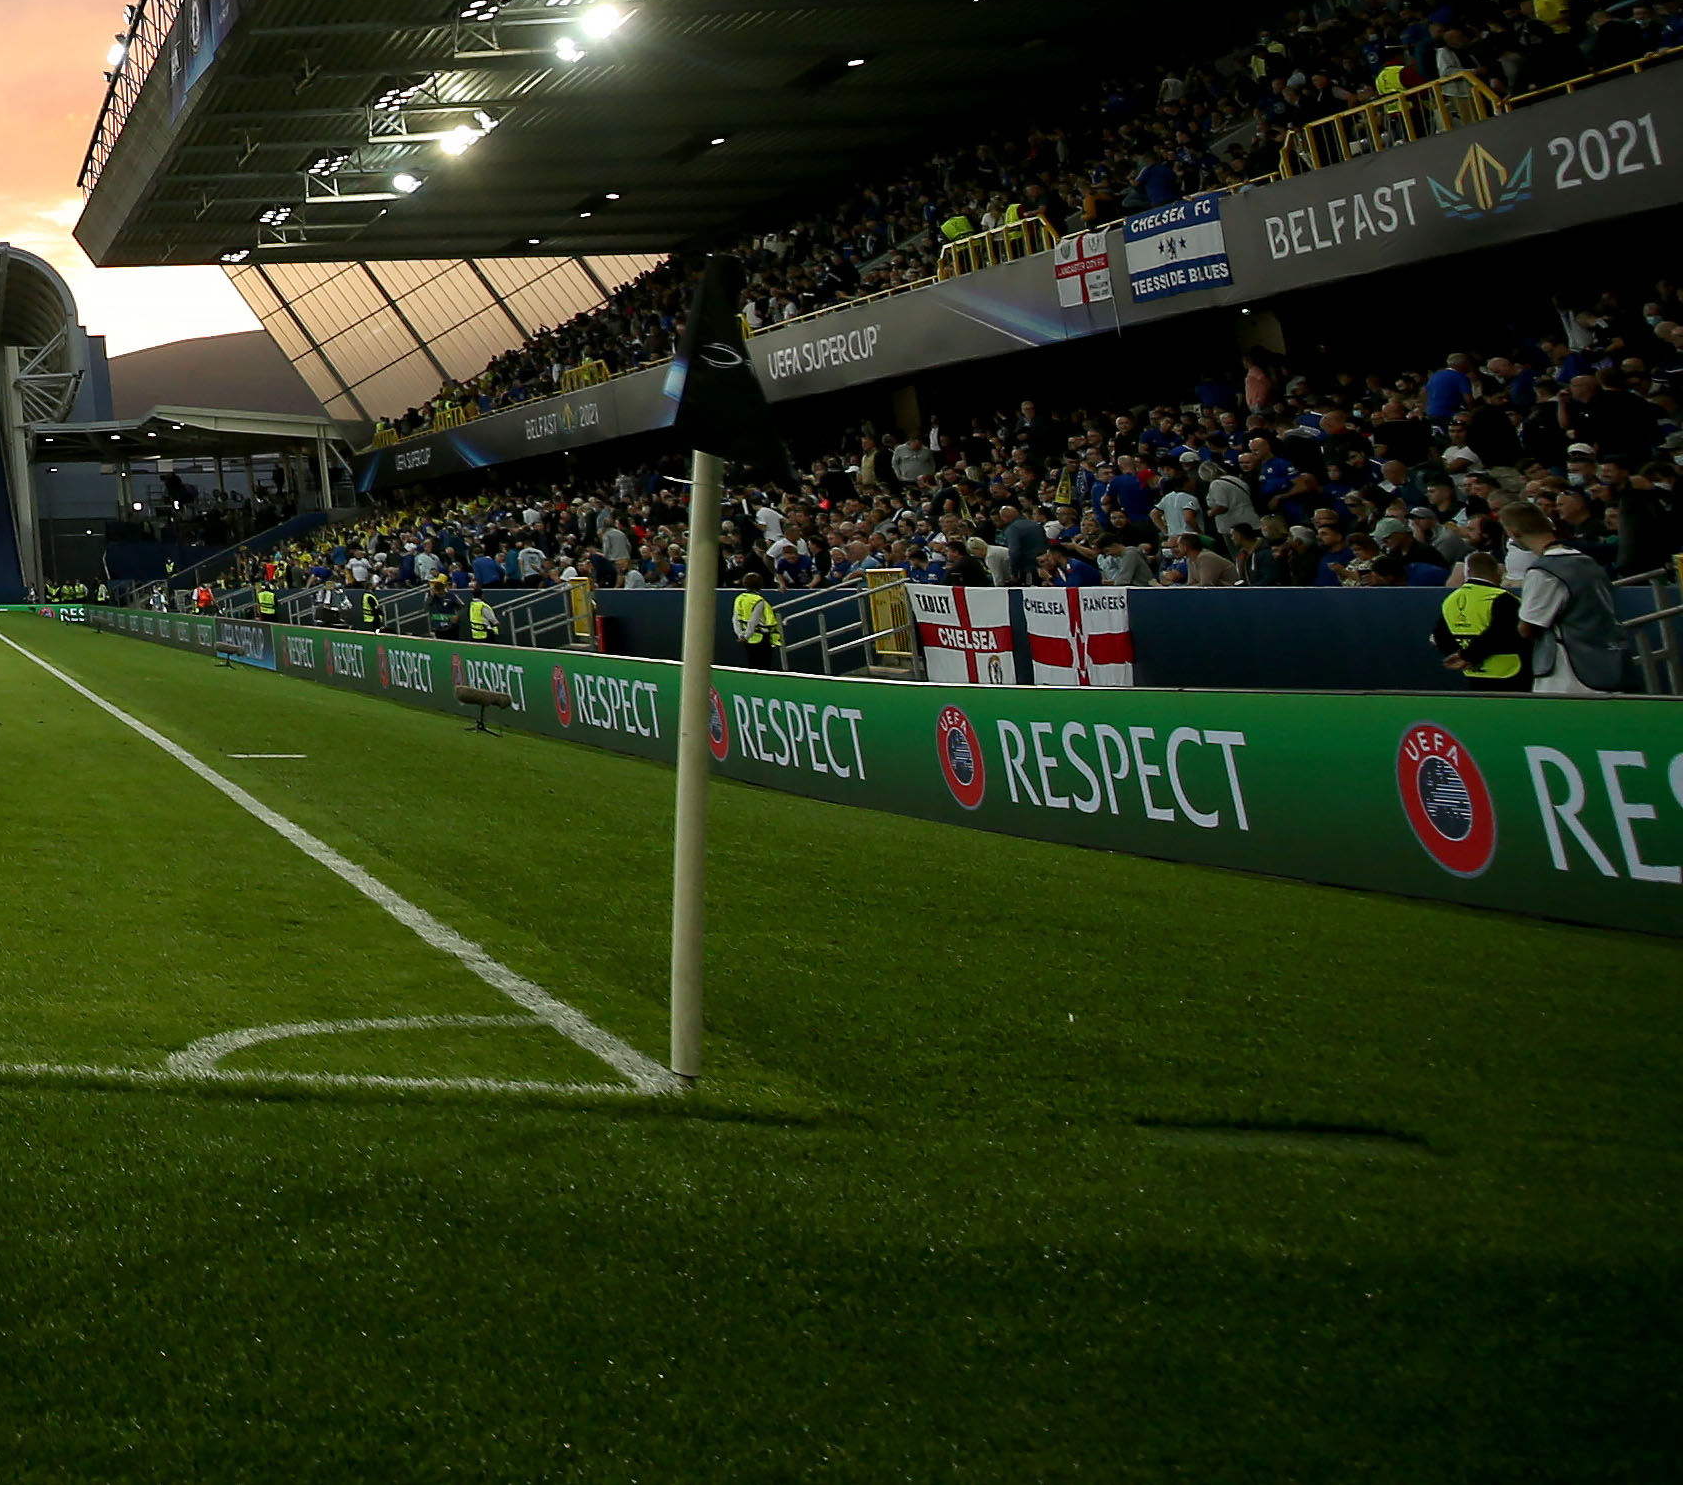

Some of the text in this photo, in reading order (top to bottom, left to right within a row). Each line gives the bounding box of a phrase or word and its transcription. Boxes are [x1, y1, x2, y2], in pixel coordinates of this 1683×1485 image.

[1265, 113, 1663, 259] BELFAST 2021
[1130, 199, 1211, 233] CHELSEA FC
[1131, 262, 1229, 296] TEESSIDE BLUES
[767, 324, 878, 380] UEFA SUPER CUP
[525, 402, 601, 440] BELFAST 2021
[915, 593, 952, 614] TADLEY
[1024, 597, 1067, 616] CHELSEA
[937, 627, 998, 650] CHELSEA
[388, 649, 433, 693] RESPECT
[574, 672, 660, 738] RESPECT
[940, 710, 967, 734] UEFA
[732, 694, 866, 780] RESPECT
[1404, 730, 1460, 767] UEFA
[996, 719, 1249, 831] RESPECT
[1524, 745, 1683, 884] RE
